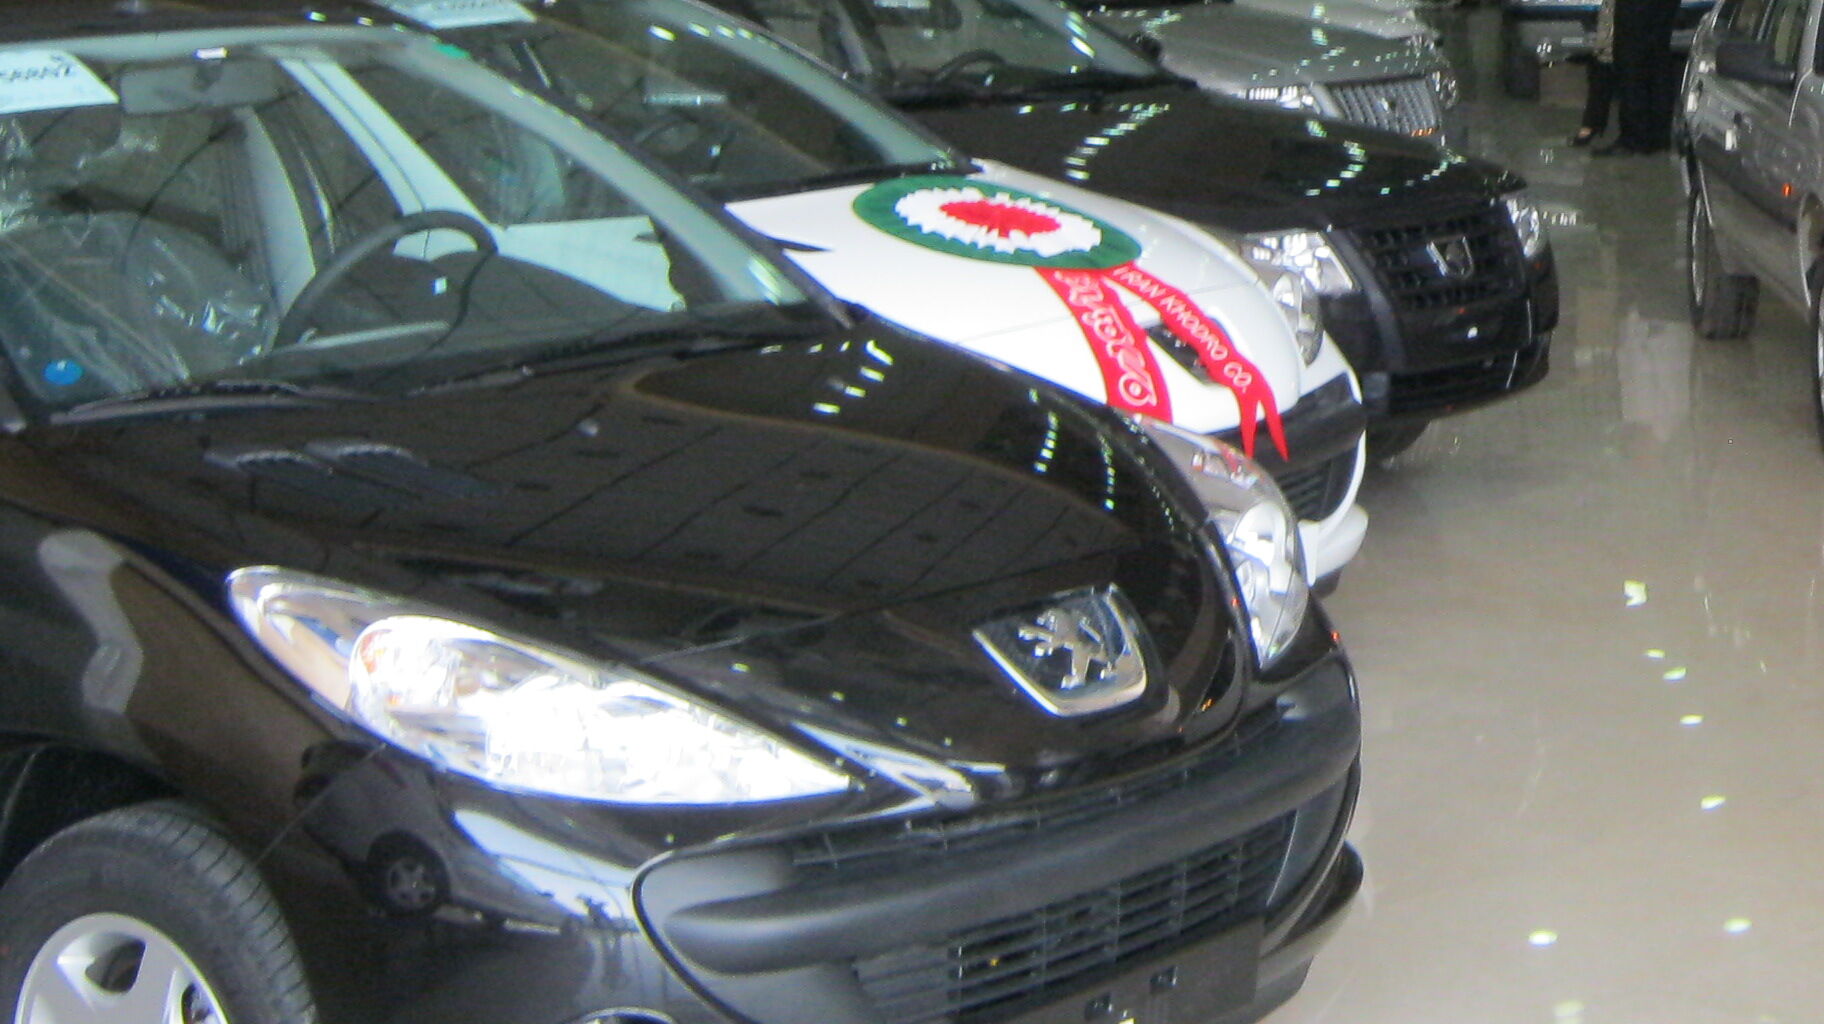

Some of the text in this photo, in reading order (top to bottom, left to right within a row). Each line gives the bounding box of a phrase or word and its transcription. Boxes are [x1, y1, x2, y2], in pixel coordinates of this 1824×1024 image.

[1113, 265, 1252, 394] IRAN KHODRO CO.
